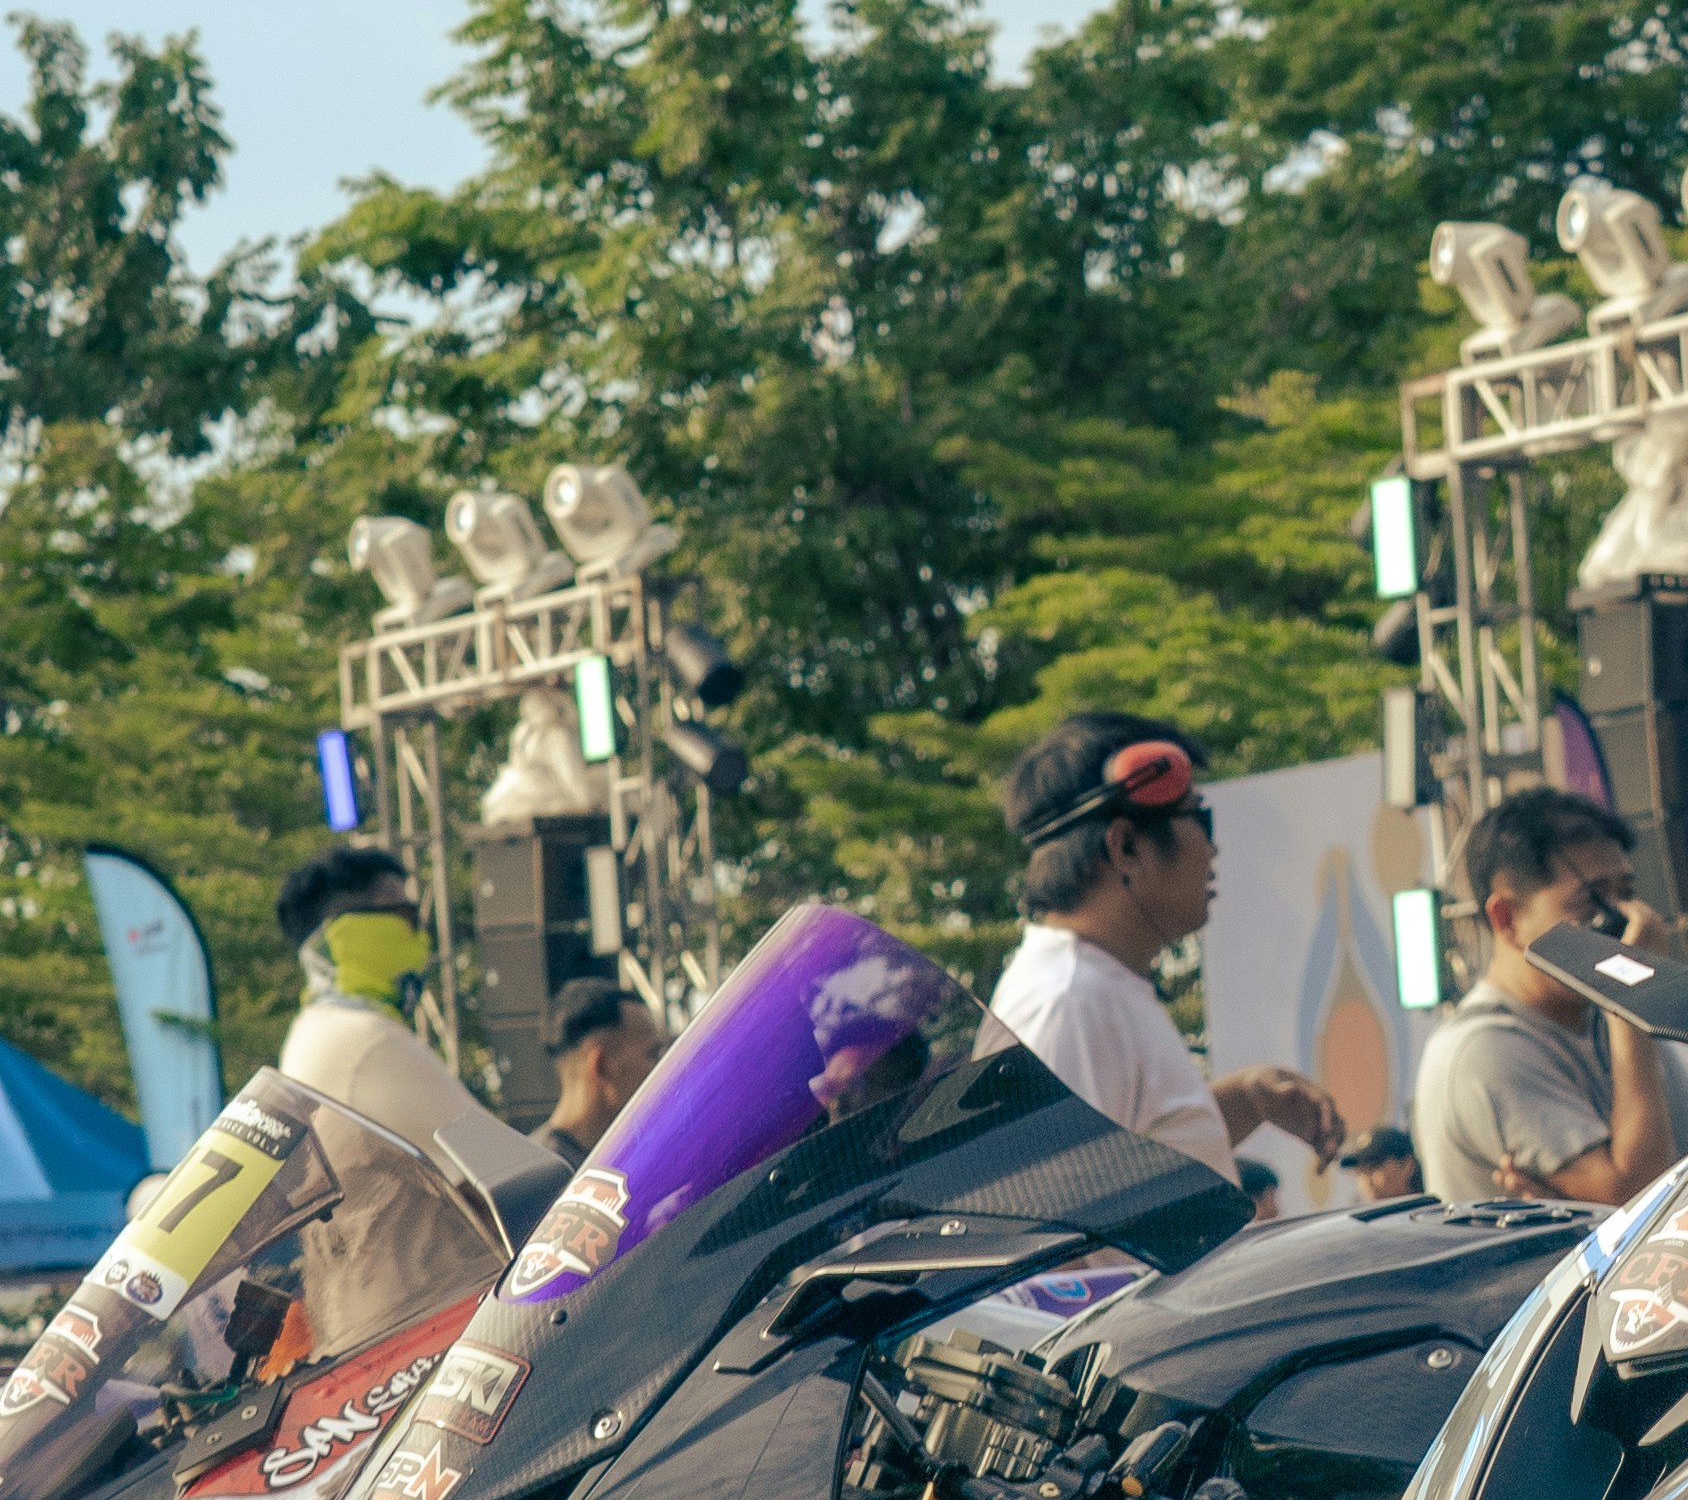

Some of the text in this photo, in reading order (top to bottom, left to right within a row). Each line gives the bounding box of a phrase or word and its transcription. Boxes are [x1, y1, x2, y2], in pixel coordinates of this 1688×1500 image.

[138, 1146, 245, 1234] 7
[543, 1213, 609, 1266] FR
[28, 1341, 87, 1397] FR
[263, 1399, 380, 1488] SAN
